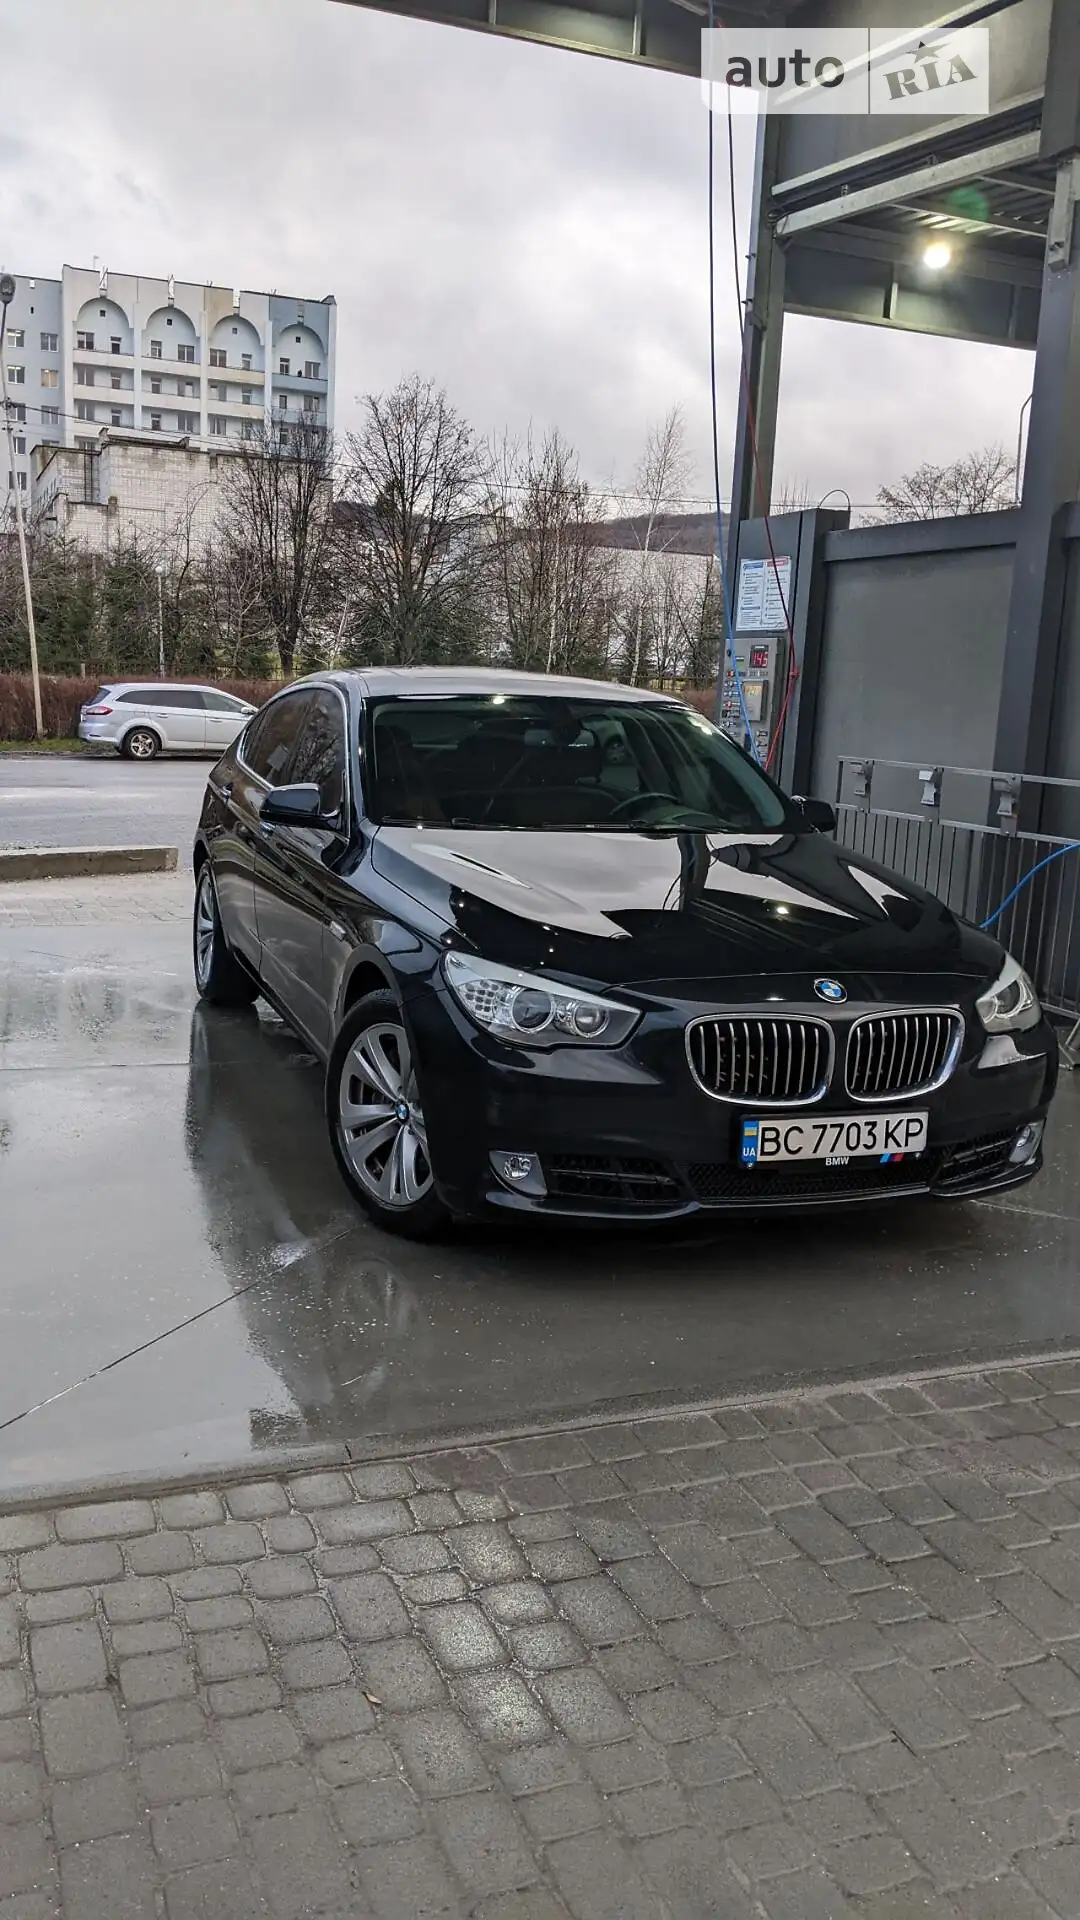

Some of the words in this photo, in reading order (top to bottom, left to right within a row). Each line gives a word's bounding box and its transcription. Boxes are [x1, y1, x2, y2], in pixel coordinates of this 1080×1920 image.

[760, 1126, 804, 1157] BC
[812, 1121, 877, 1154] 7703
[884, 1118, 924, 1149] KP
[743, 1147, 756, 1157] UA
[825, 1156, 850, 1166] BMW
